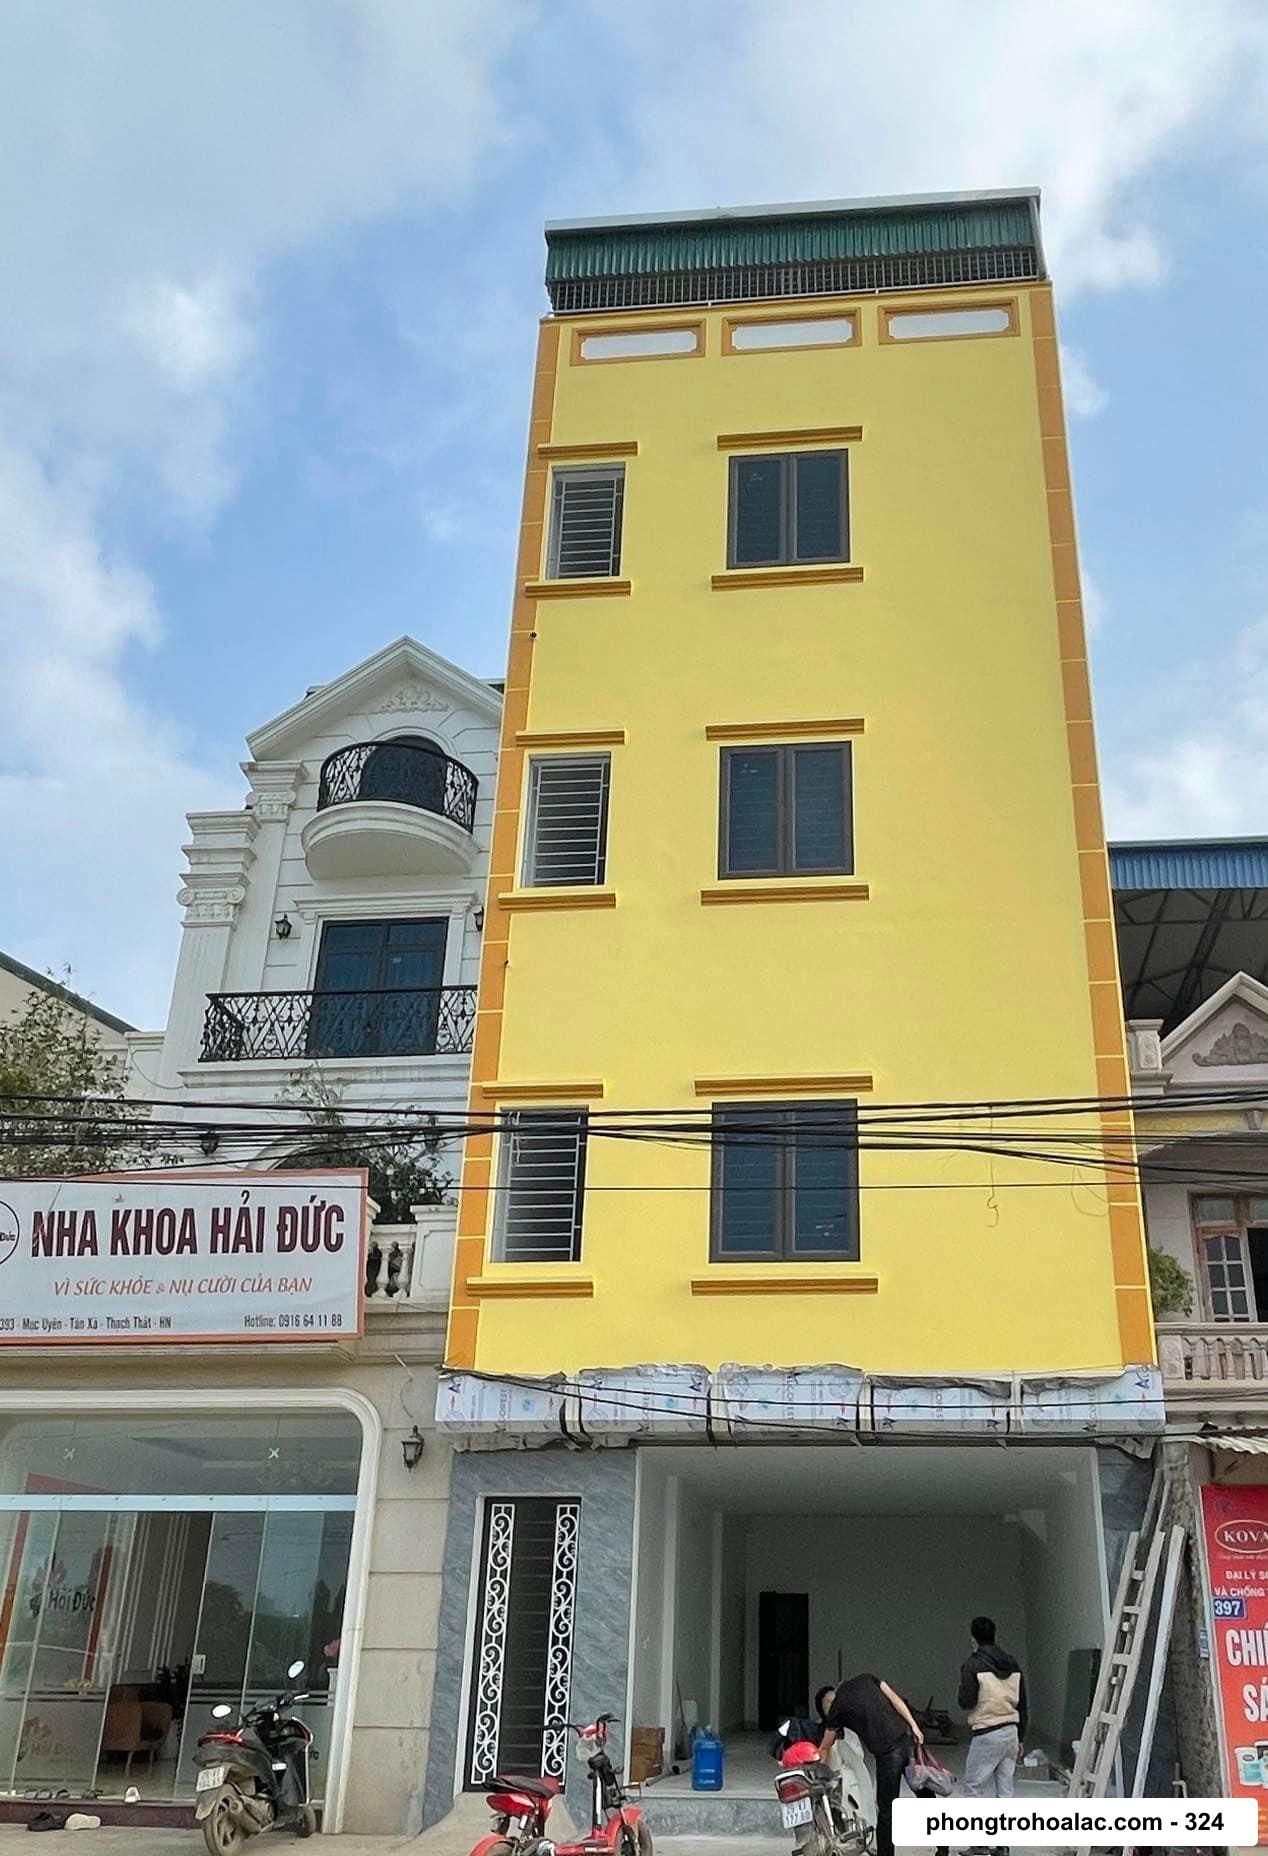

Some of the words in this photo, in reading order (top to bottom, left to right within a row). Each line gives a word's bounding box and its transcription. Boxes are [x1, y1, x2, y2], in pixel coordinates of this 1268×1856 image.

[32, 1210, 98, 1257] NHA
[110, 1208, 198, 1255] KHOA
[209, 1190, 266, 1254] HẢI
[276, 1195, 345, 1253] ĐỨC
[54, 1276, 71, 1296] VÌ
[73, 1277, 106, 1296] SỨC
[109, 1275, 153, 1295] KHỎE
[169, 1279, 194, 1296] NỤ
[198, 1275, 237, 1294] CƯỜI
[240, 1272, 273, 1293] CỦA
[278, 1276, 313, 1296] BẠN
[159, 1315, 172, 1329] HN
[278, 1314, 301, 1328] 0916
[303, 1314, 314, 1327] 64
[318, 1314, 328, 1327] 11
[331, 1313, 342, 1327] 88
[1213, 1585, 1228, 1596] VÀ
[1214, 1600, 1240, 1616] 397
